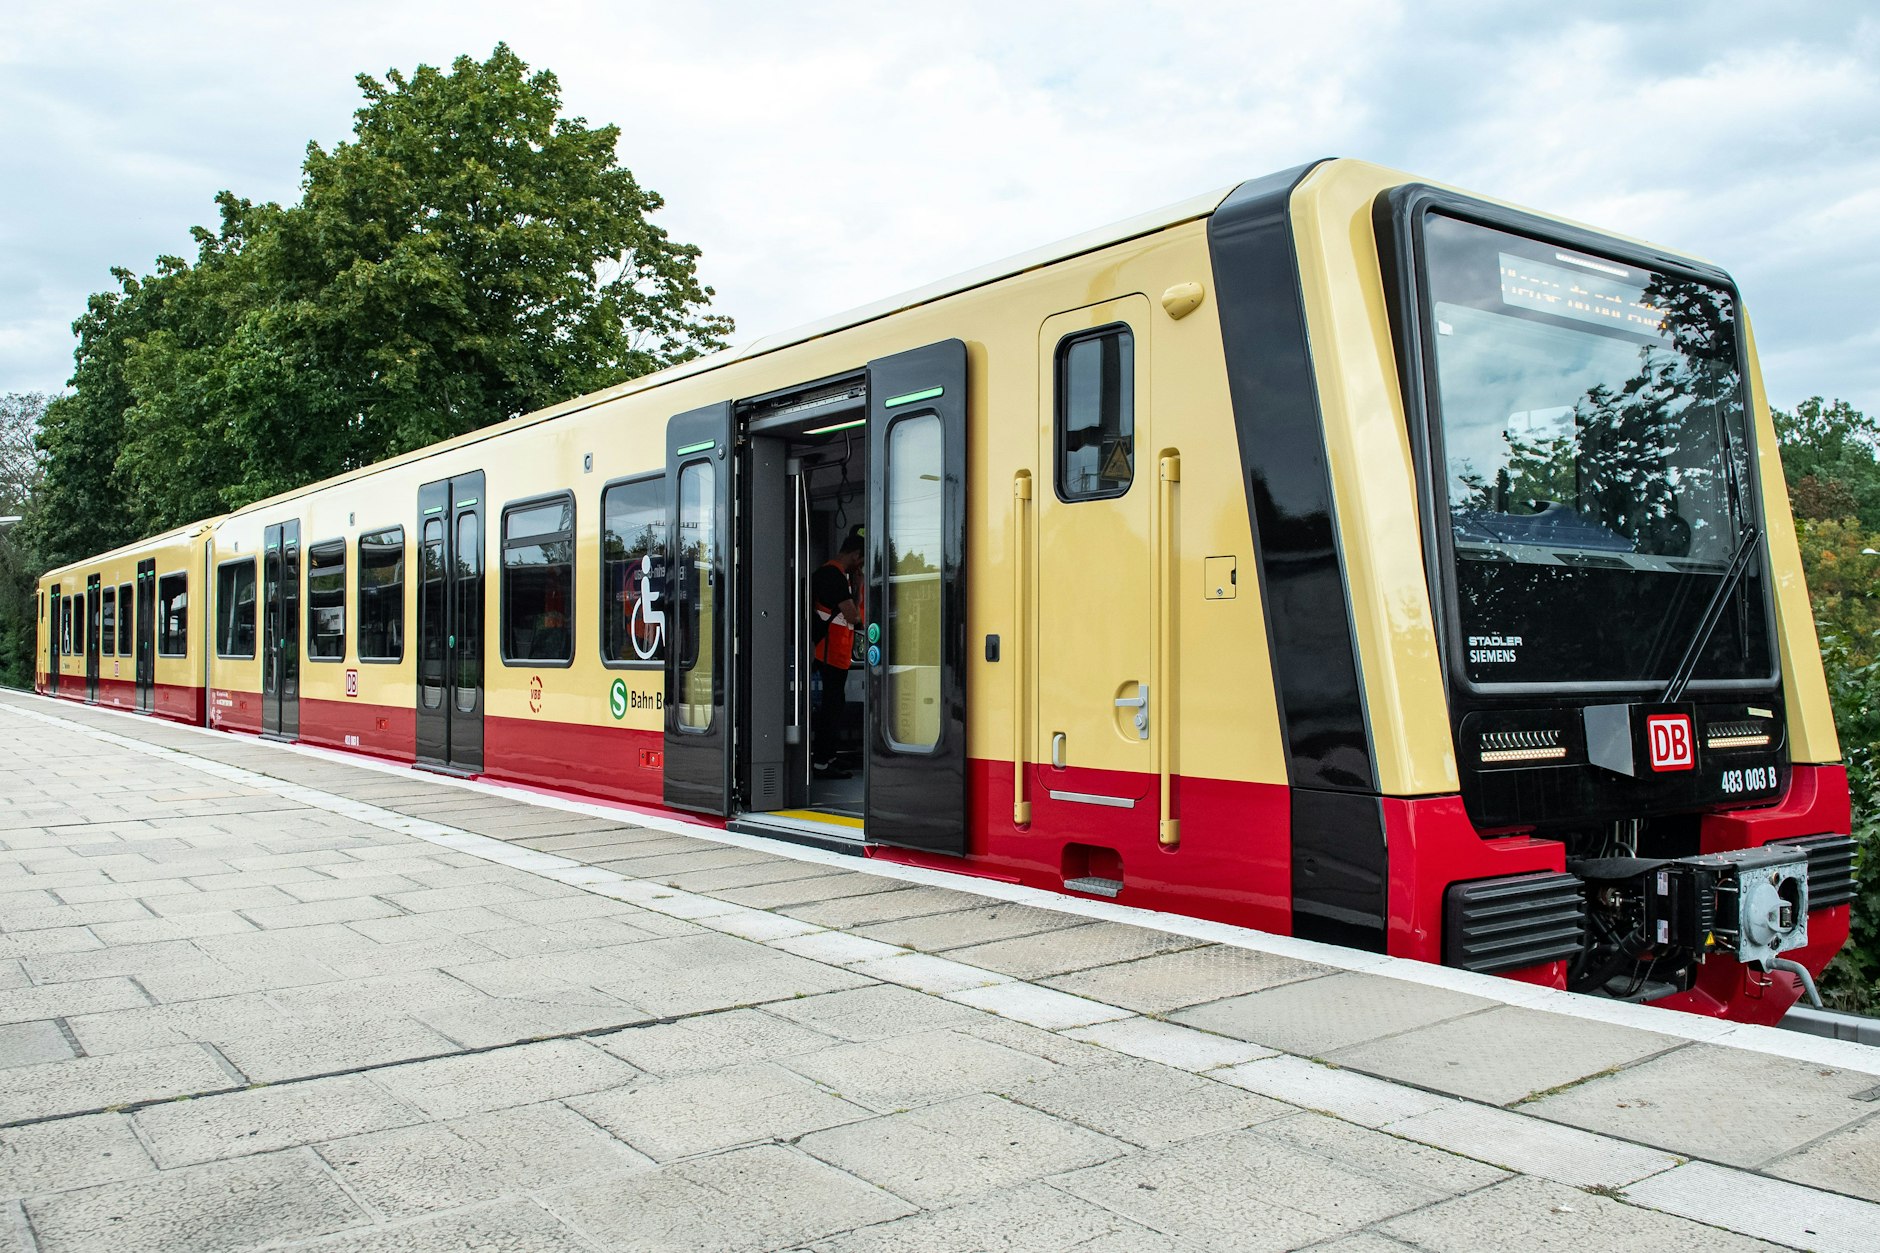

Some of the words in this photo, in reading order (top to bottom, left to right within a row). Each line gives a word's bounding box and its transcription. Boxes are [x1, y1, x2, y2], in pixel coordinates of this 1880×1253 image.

[1468, 636, 1523, 646] STADLER
[1469, 649, 1517, 663] SIEMENS
[347, 673, 357, 693] DB
[530, 688, 541, 700] VBB
[612, 682, 626, 716] S
[631, 690, 653, 709] Bahn
[1652, 723, 1688, 762] DB
[1721, 769, 1743, 793] 483
[1745, 767, 1767, 791] 003
[1768, 766, 1777, 788] B
